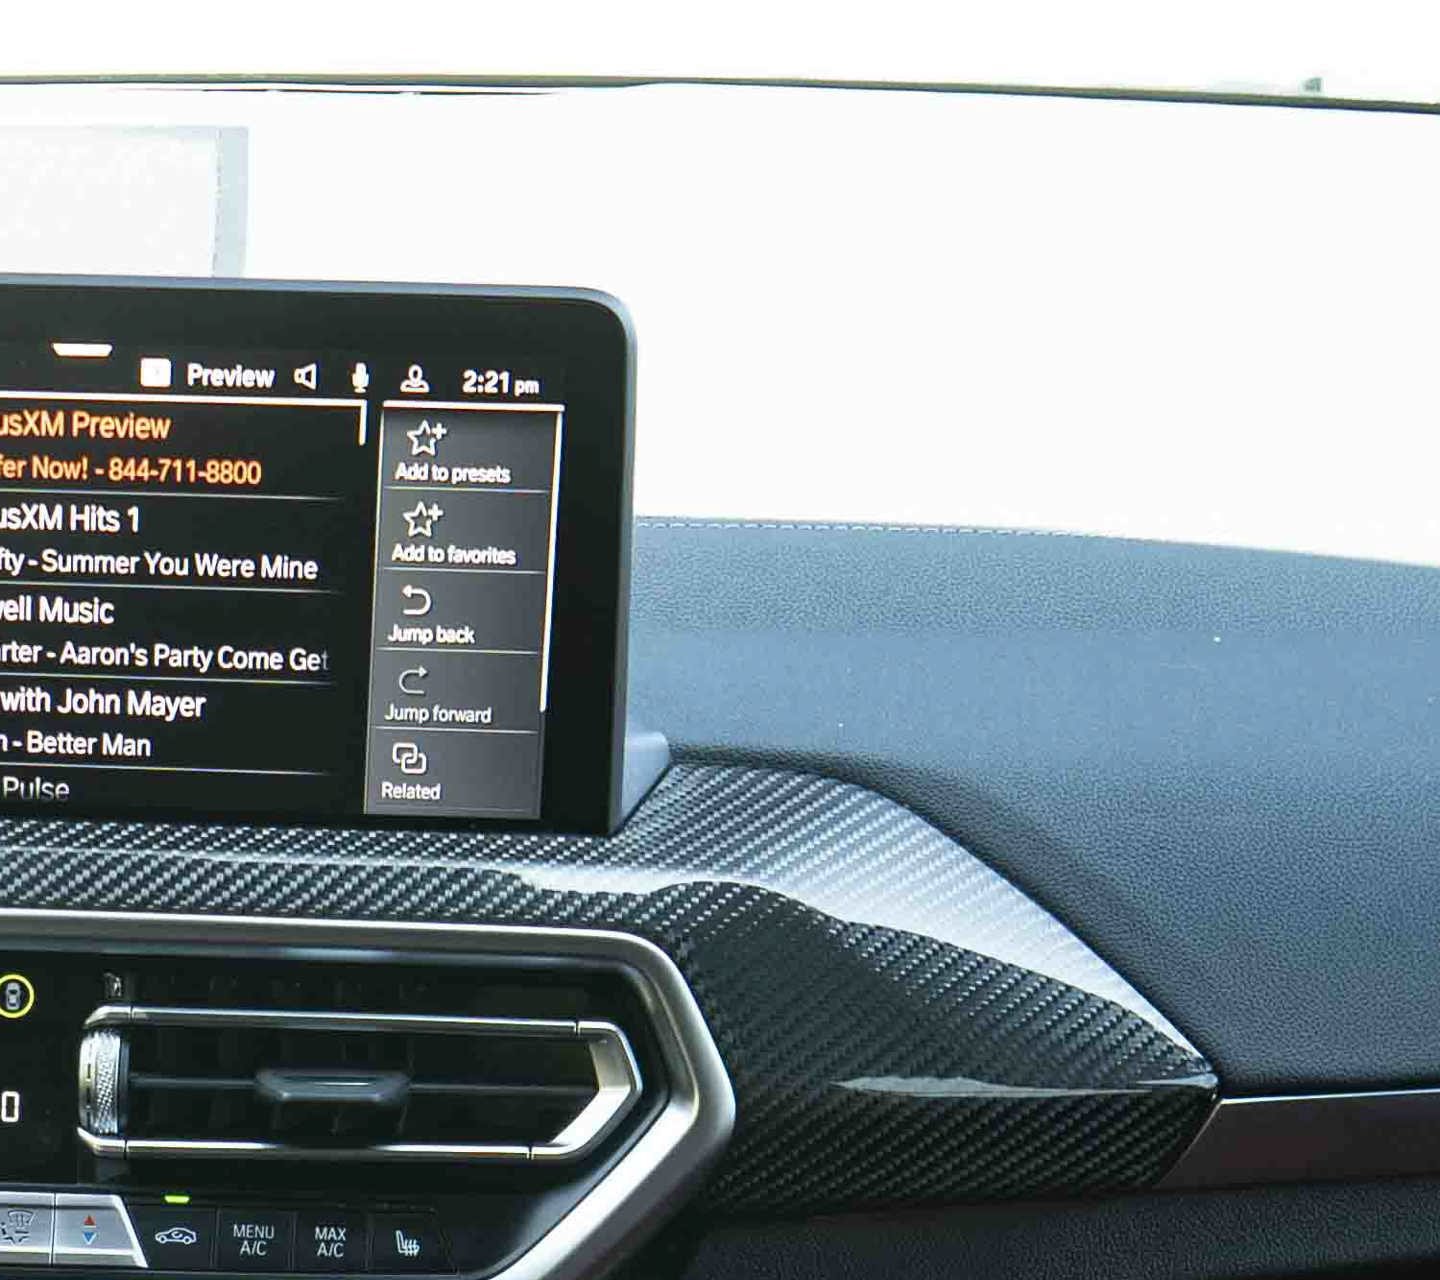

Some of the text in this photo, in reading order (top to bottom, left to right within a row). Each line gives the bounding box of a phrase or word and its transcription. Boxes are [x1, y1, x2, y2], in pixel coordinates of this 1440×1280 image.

[187, 364, 275, 390] Preview
[463, 370, 539, 398] 2:21 pm
[72, 411, 170, 441] Preview
[32, 456, 88, 481] Now!
[108, 459, 262, 485] 844-711-8800
[394, 464, 511, 486] Add to presets
[69, 504, 120, 532] Hits
[128, 506, 139, 533] 1
[41, 549, 140, 576] Summer
[145, 552, 189, 576] You
[195, 553, 255, 577] Were
[261, 554, 318, 580] Mine
[392, 546, 516, 565] Add to favorites
[39, 596, 115, 625] Music
[388, 626, 475, 645] Jump back
[60, 641, 148, 668] Aaron's
[153, 644, 212, 673] Party
[217, 645, 283, 670] Come
[289, 647, 329, 671] Get
[0, 685, 51, 713] with
[57, 688, 120, 715] John
[127, 690, 206, 722] Mayer
[384, 705, 491, 725] Jump forward
[27, 731, 96, 755] Better
[102, 732, 151, 756] Man
[3, 777, 70, 801] Pulse
[382, 782, 441, 800] Related
[233, 1224, 275, 1240] MENU
[315, 1227, 346, 1241] MAX
[240, 1241, 267, 1256] A/C
[317, 1243, 344, 1258] A/C
